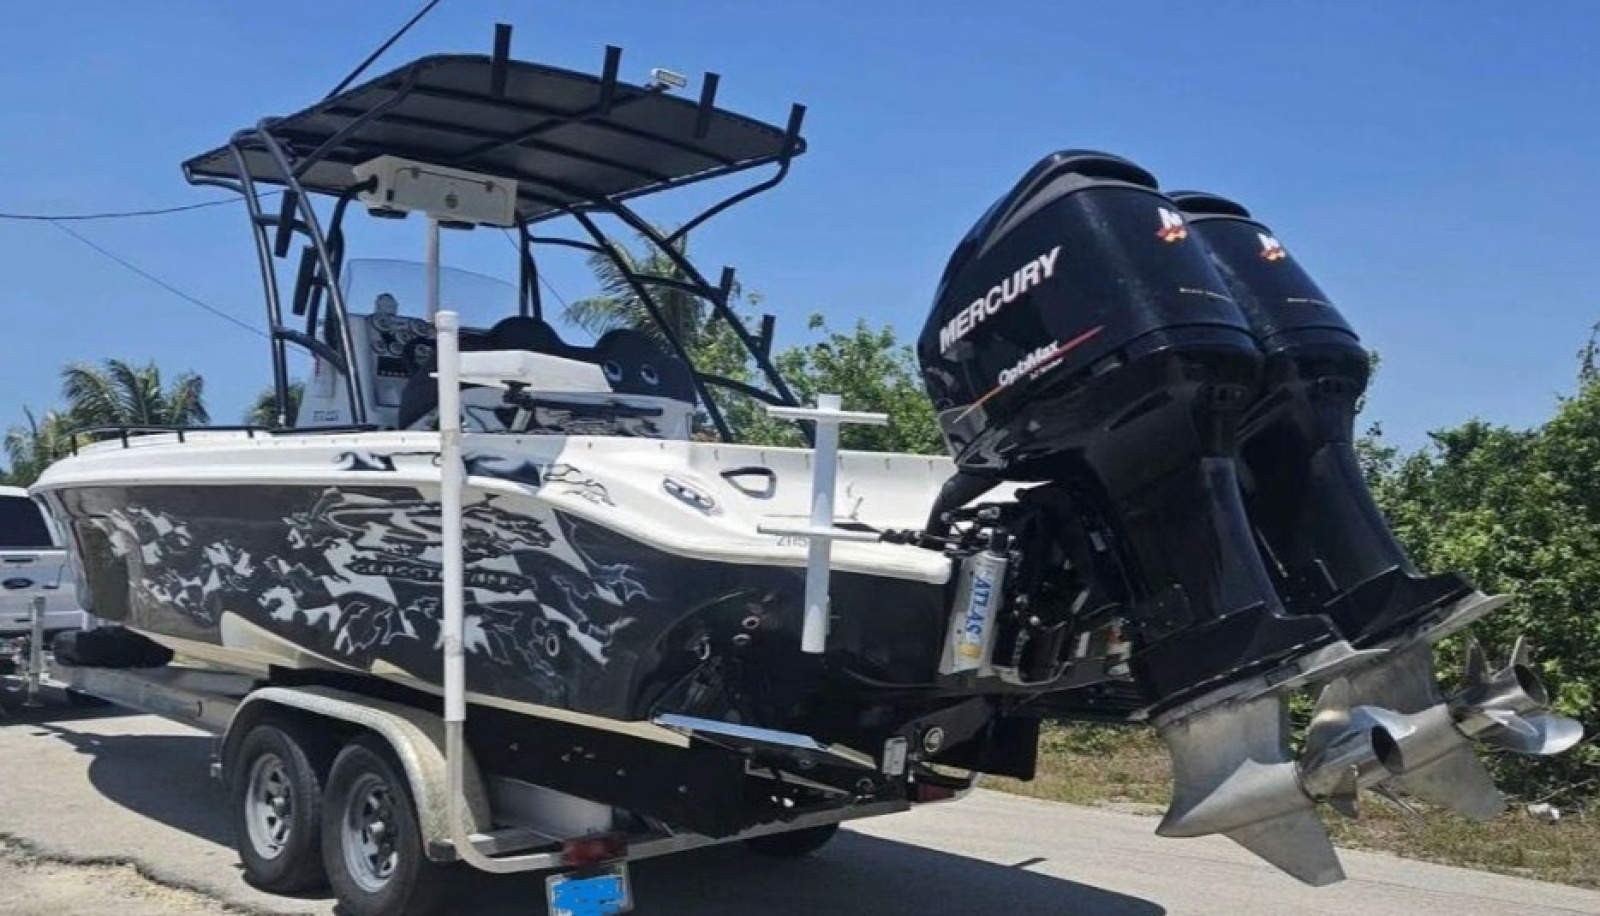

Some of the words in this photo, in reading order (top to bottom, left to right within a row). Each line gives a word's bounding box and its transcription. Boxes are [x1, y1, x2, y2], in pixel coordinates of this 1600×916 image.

[938, 245, 1062, 355] MERCURY
[998, 340, 1060, 386] OptiMax
[963, 574, 991, 636] ATLAS
